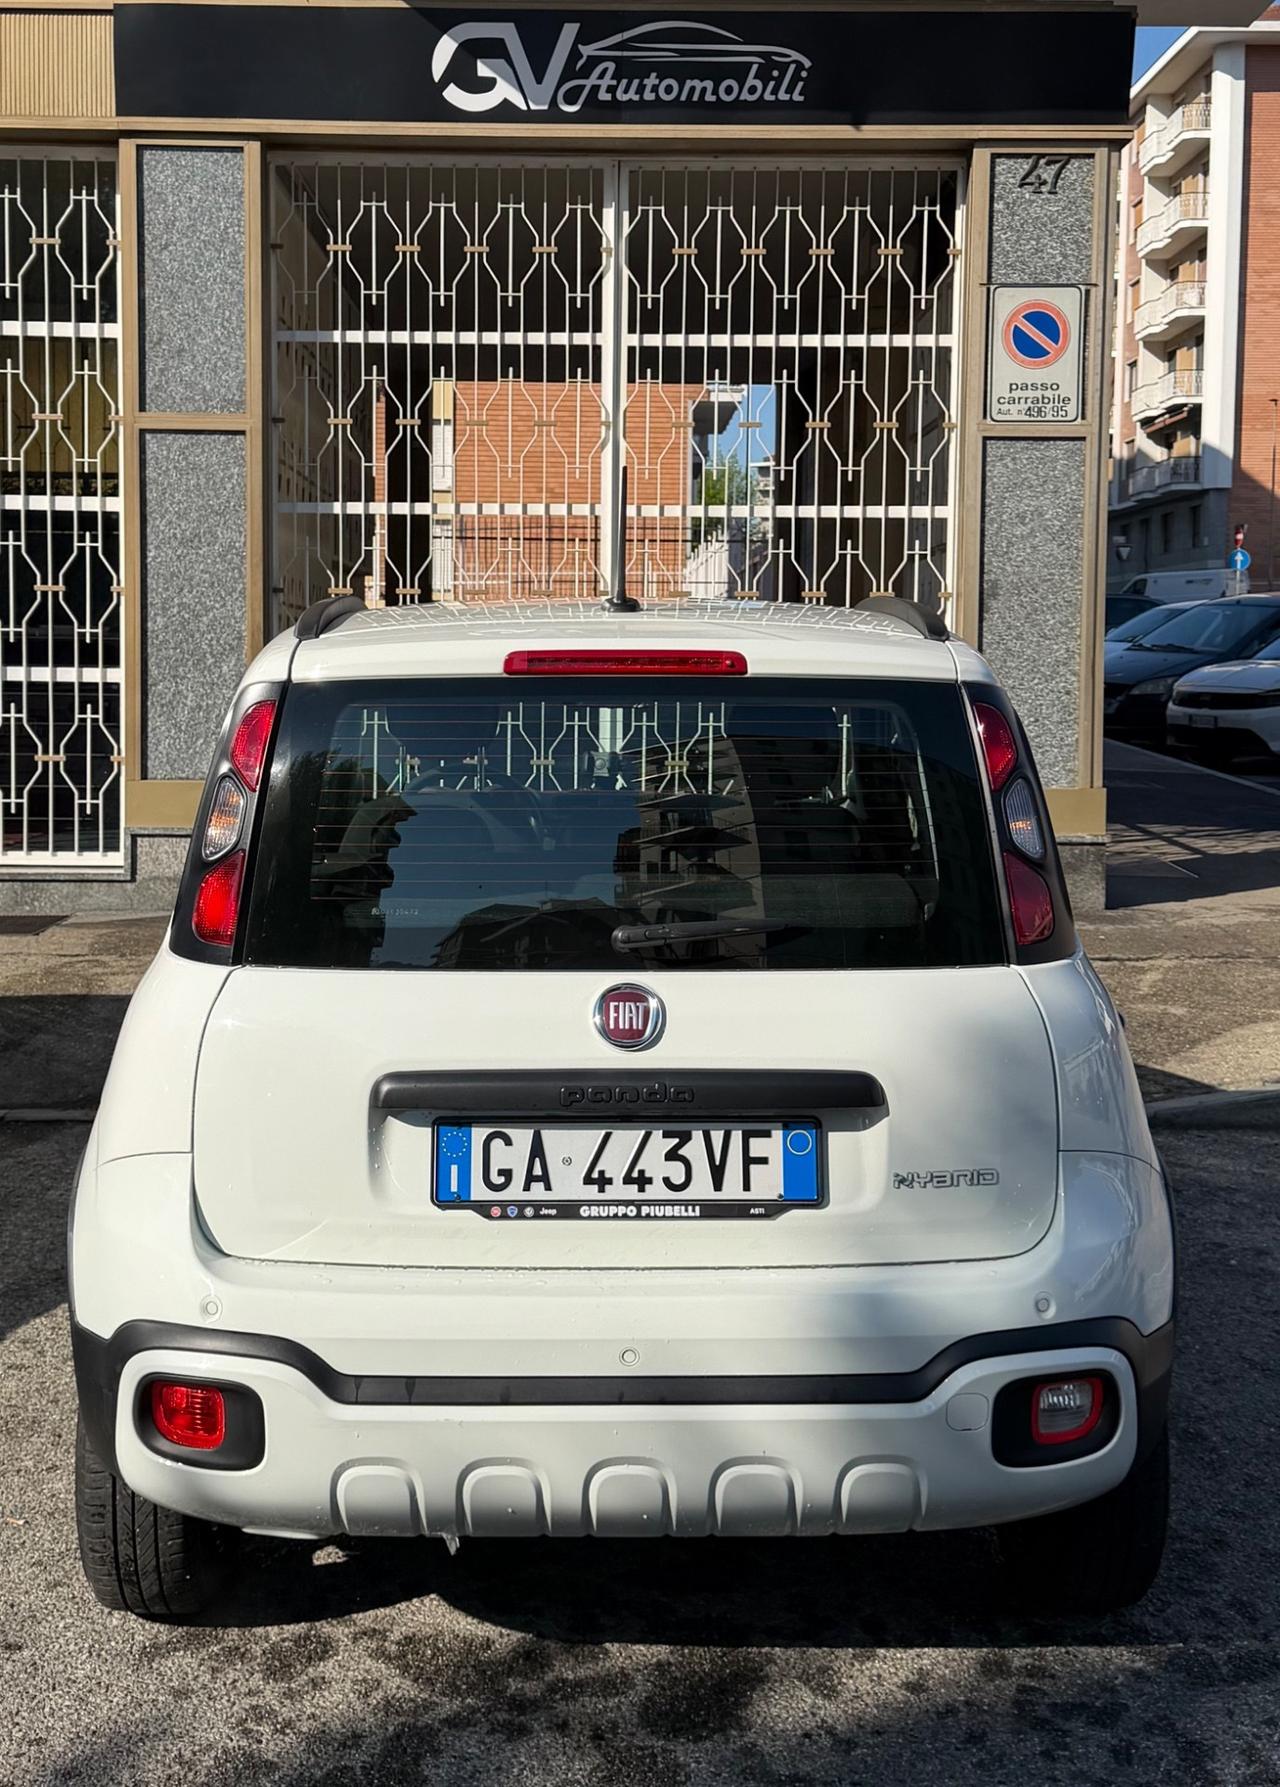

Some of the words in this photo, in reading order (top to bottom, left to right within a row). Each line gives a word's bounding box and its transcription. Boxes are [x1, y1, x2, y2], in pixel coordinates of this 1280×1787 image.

[431, 22, 581, 112] GV
[557, 61, 809, 113] Automobili
[1018, 155, 1071, 194] 47
[997, 393, 1071, 405] carrabile
[1009, 382, 1060, 394] passo
[997, 408, 1014, 416] Aut.
[609, 1001, 648, 1030] FIAT
[560, 1082, 695, 1107] panda
[481, 1129, 553, 1193] GA
[582, 1129, 772, 1193] 443VF
[539, 1207, 557, 1216] Jeep
[579, 1205, 637, 1217] GRUPPO
[641, 1205, 700, 1217] PIUBELLI
[750, 1207, 765, 1215] ASTI
